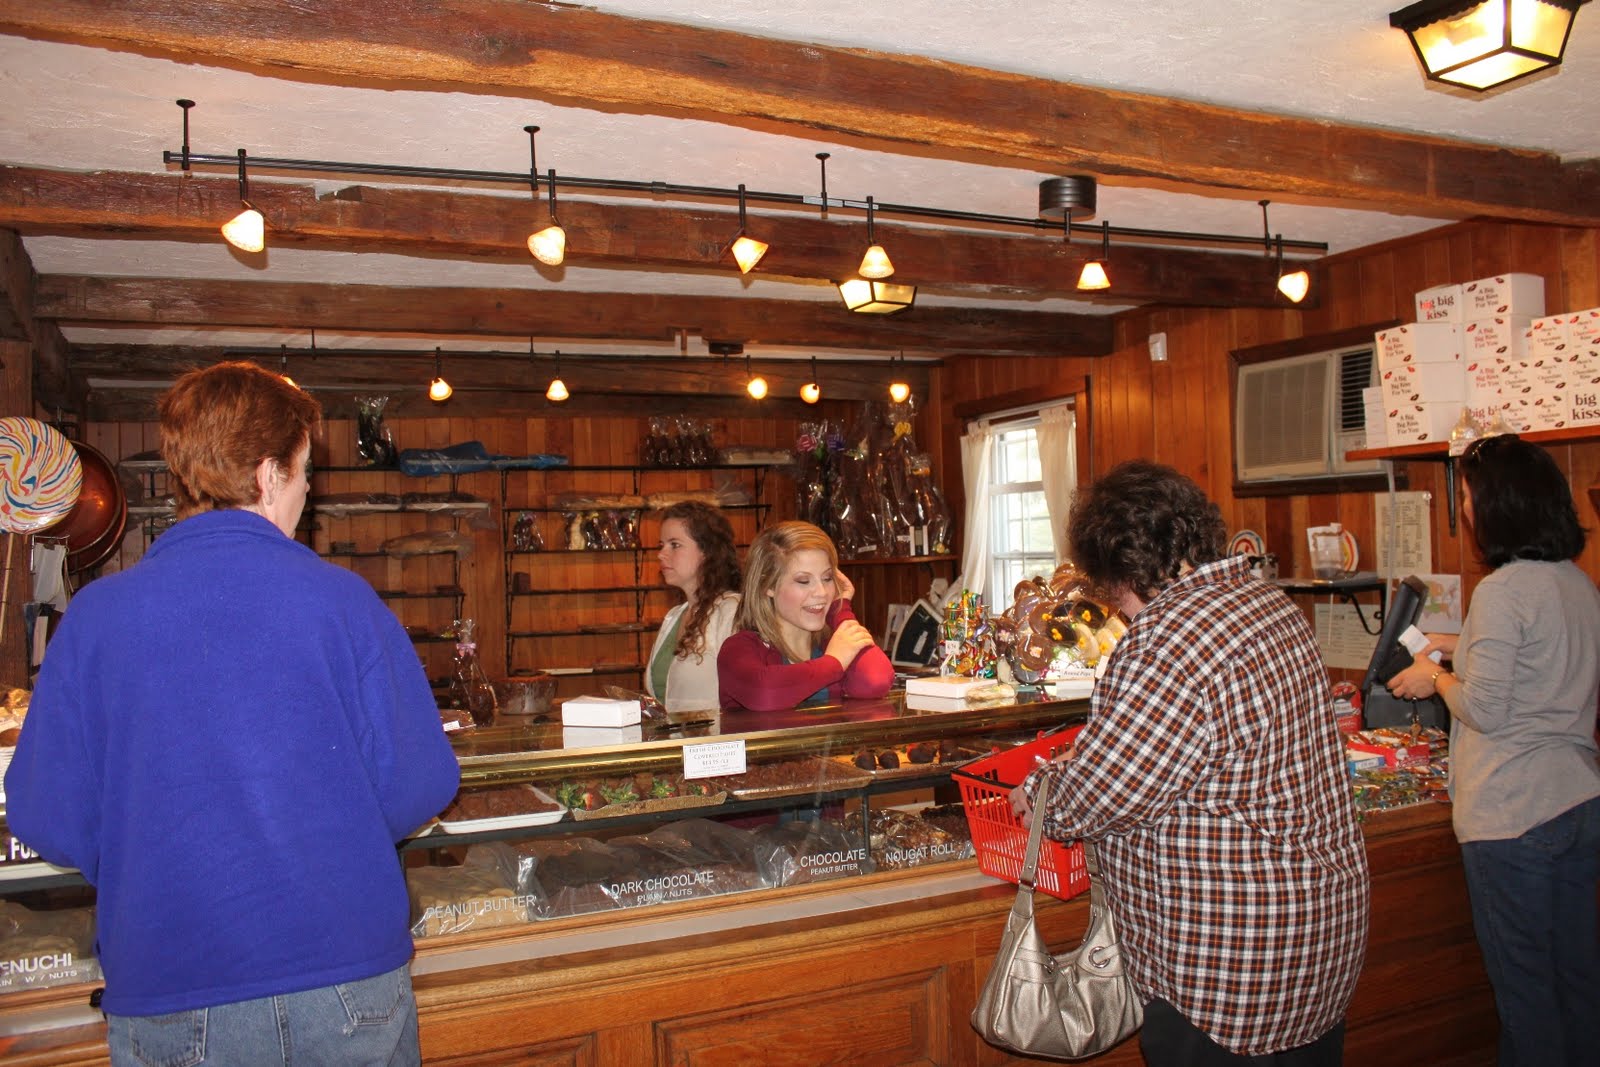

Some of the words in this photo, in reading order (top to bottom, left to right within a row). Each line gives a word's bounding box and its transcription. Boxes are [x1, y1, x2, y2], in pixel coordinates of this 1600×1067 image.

[1437, 295, 1455, 306] big
[1426, 309, 1448, 320] kiss
[1575, 394, 1597, 407] big
[1572, 408, 1600, 420] kiss
[800, 848, 866, 868] CHOCOLATE
[885, 847, 928, 864] NOUGAT
[930, 843, 956, 855] ROLL
[810, 866, 834, 875] PEANUT
[835, 863, 858, 872] BUTTER
[611, 880, 643, 897] DARK
[645, 870, 714, 891] CHOCOLATE
[425, 901, 480, 920] PEANUT
[483, 894, 536, 912] BUTTER
[49, 970, 77, 980] NUTS
